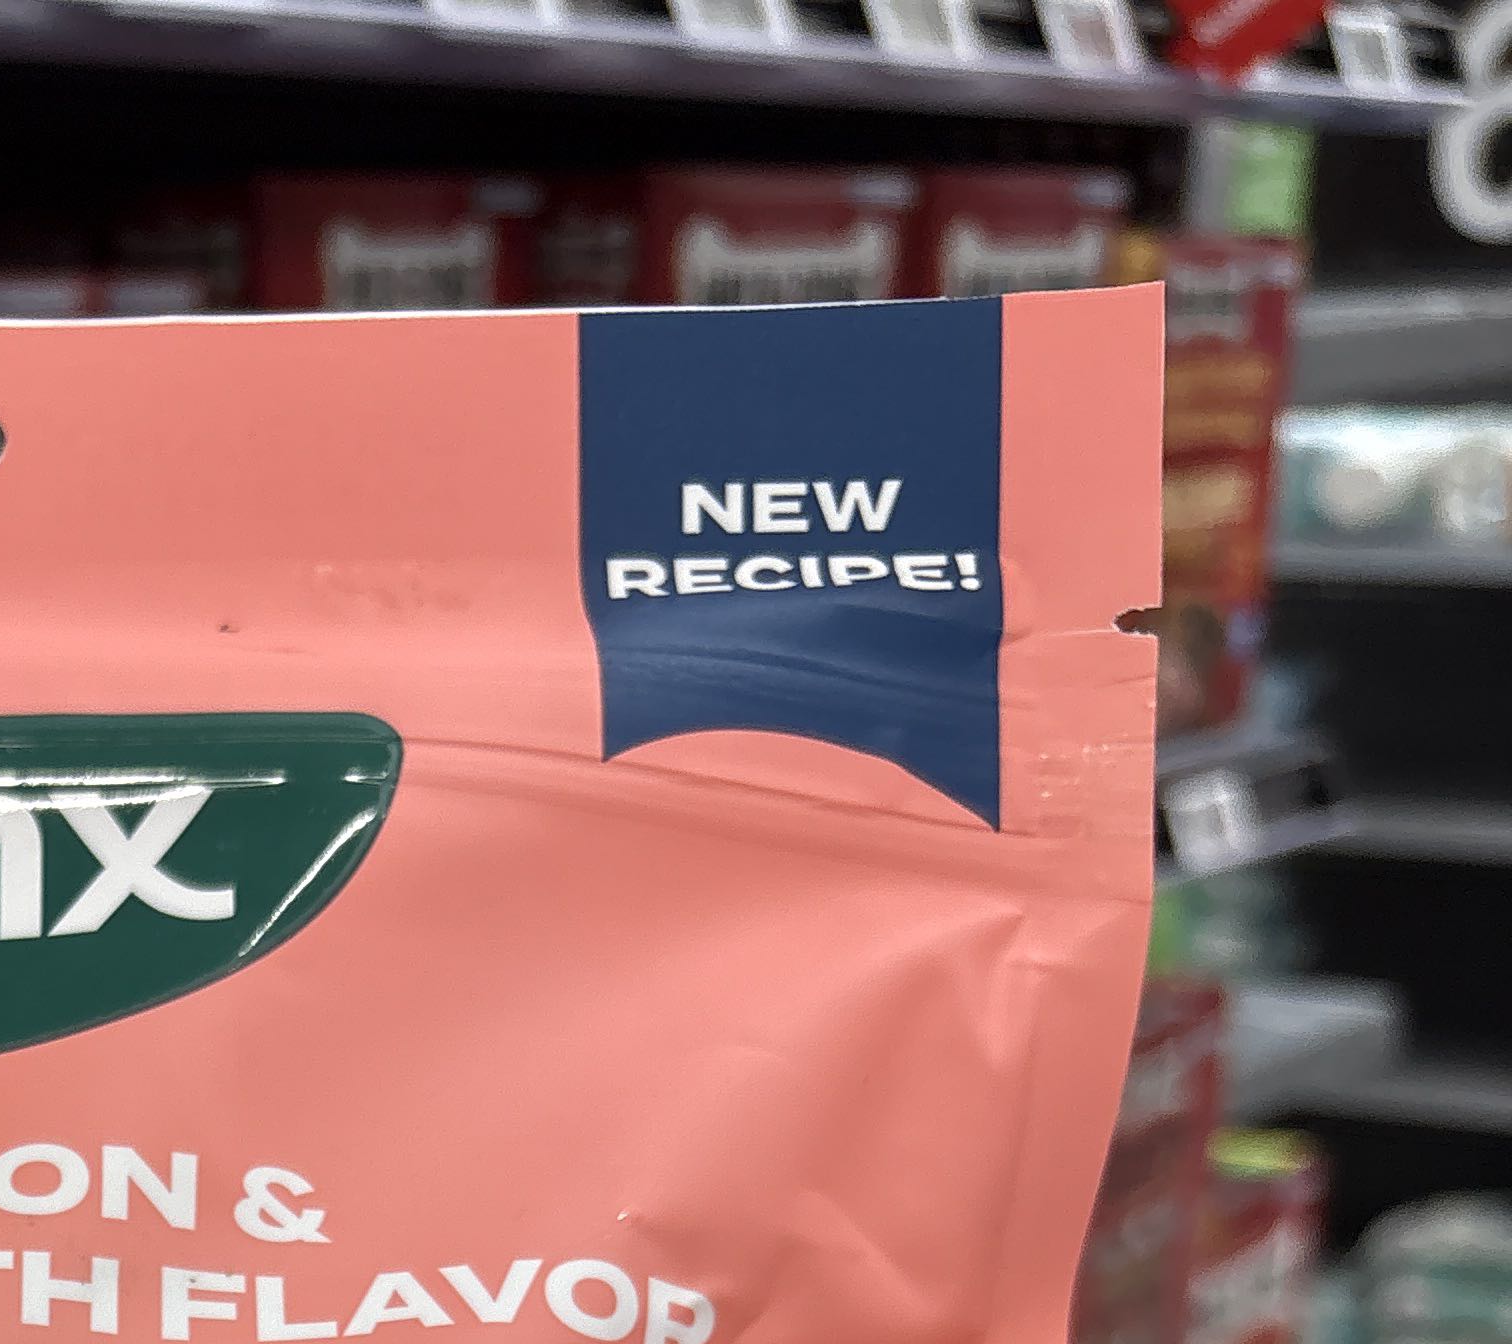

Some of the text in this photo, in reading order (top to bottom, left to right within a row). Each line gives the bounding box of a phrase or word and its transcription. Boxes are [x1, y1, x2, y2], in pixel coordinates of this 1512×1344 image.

[680, 479, 904, 535] NEW
[605, 553, 983, 601] RECIPE!
[233, 1166, 333, 1244] &
